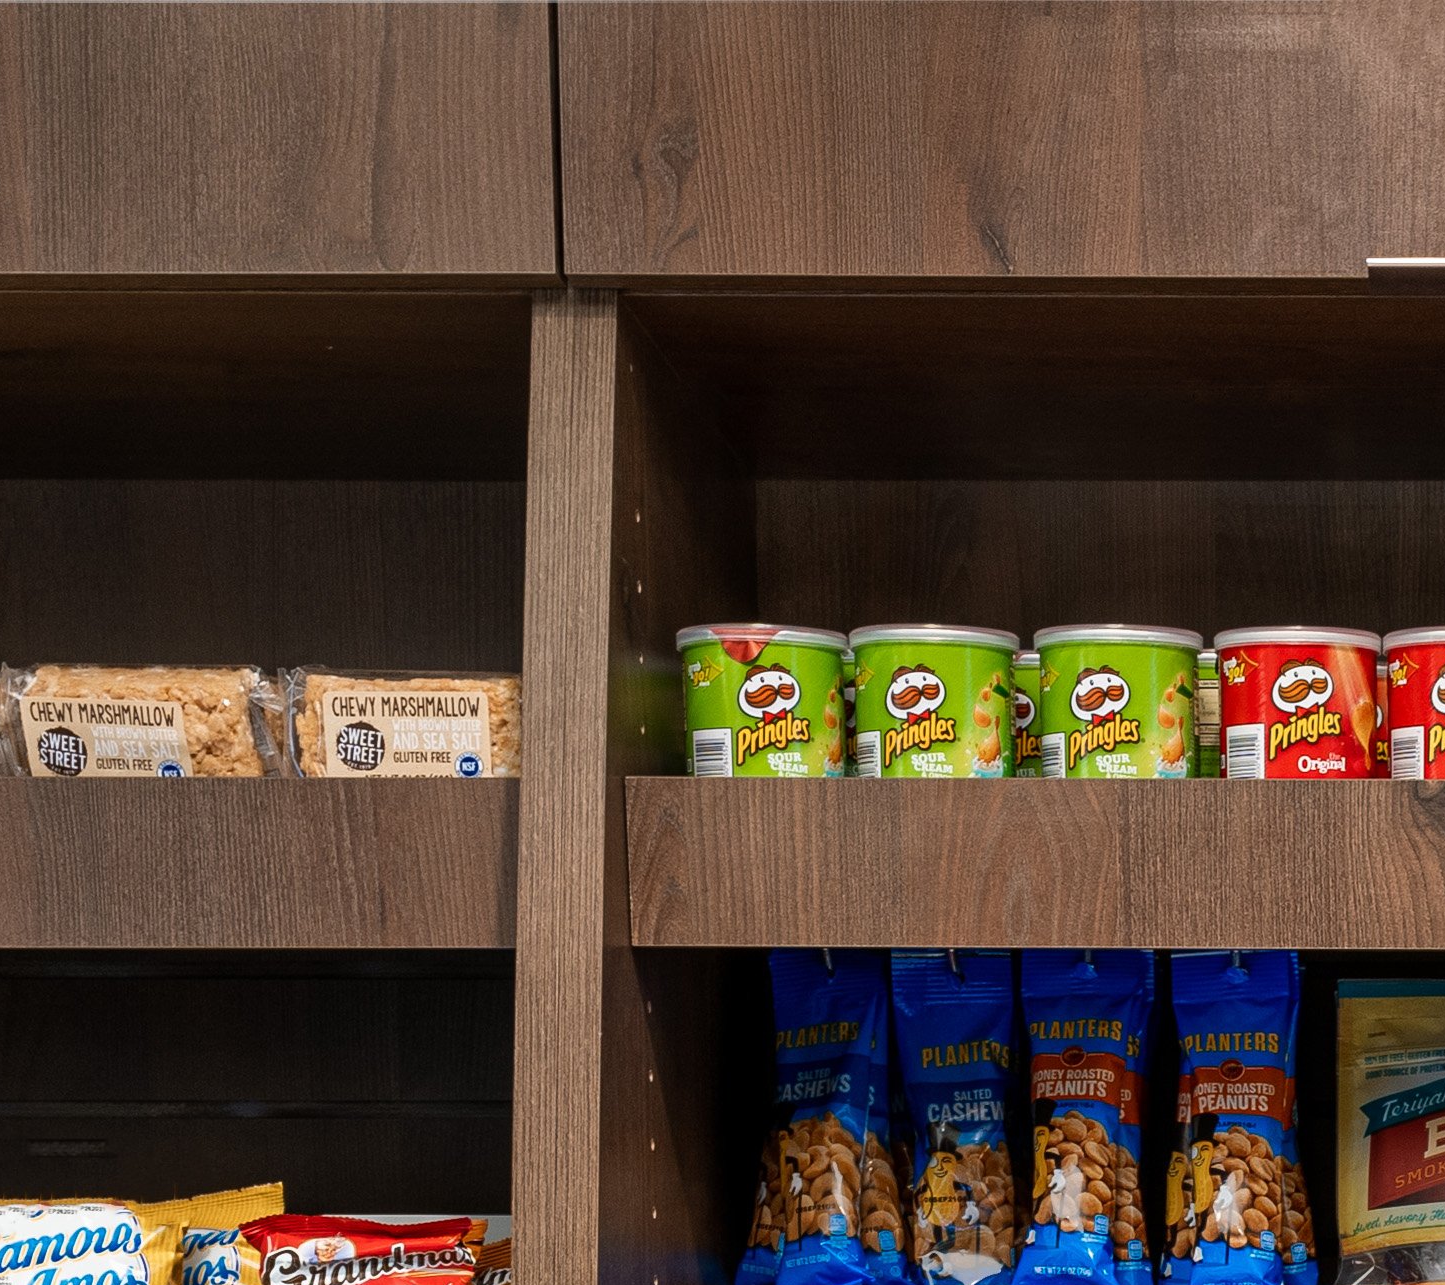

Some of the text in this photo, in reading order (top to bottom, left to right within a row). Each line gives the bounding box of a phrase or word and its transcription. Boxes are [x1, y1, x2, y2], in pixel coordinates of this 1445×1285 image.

[30, 701, 174, 727] CHEWY MARSHMALLOW
[332, 697, 479, 717] CHEWY MARSHMALLOW
[339, 726, 383, 747] SWEET
[393, 732, 481, 750] AND SEA SALT
[1066, 711, 1141, 762] Pringles
[1269, 706, 1343, 759] Pringles
[337, 743, 383, 764] STREET
[394, 751, 451, 763] GLUTEN FREE
[96, 758, 153, 771] GLUTEN FREE
[462, 760, 476, 771] NSF
[1184, 1032, 1280, 1056] PLANTERS
[1035, 1079, 1109, 1100] PEANUTS
